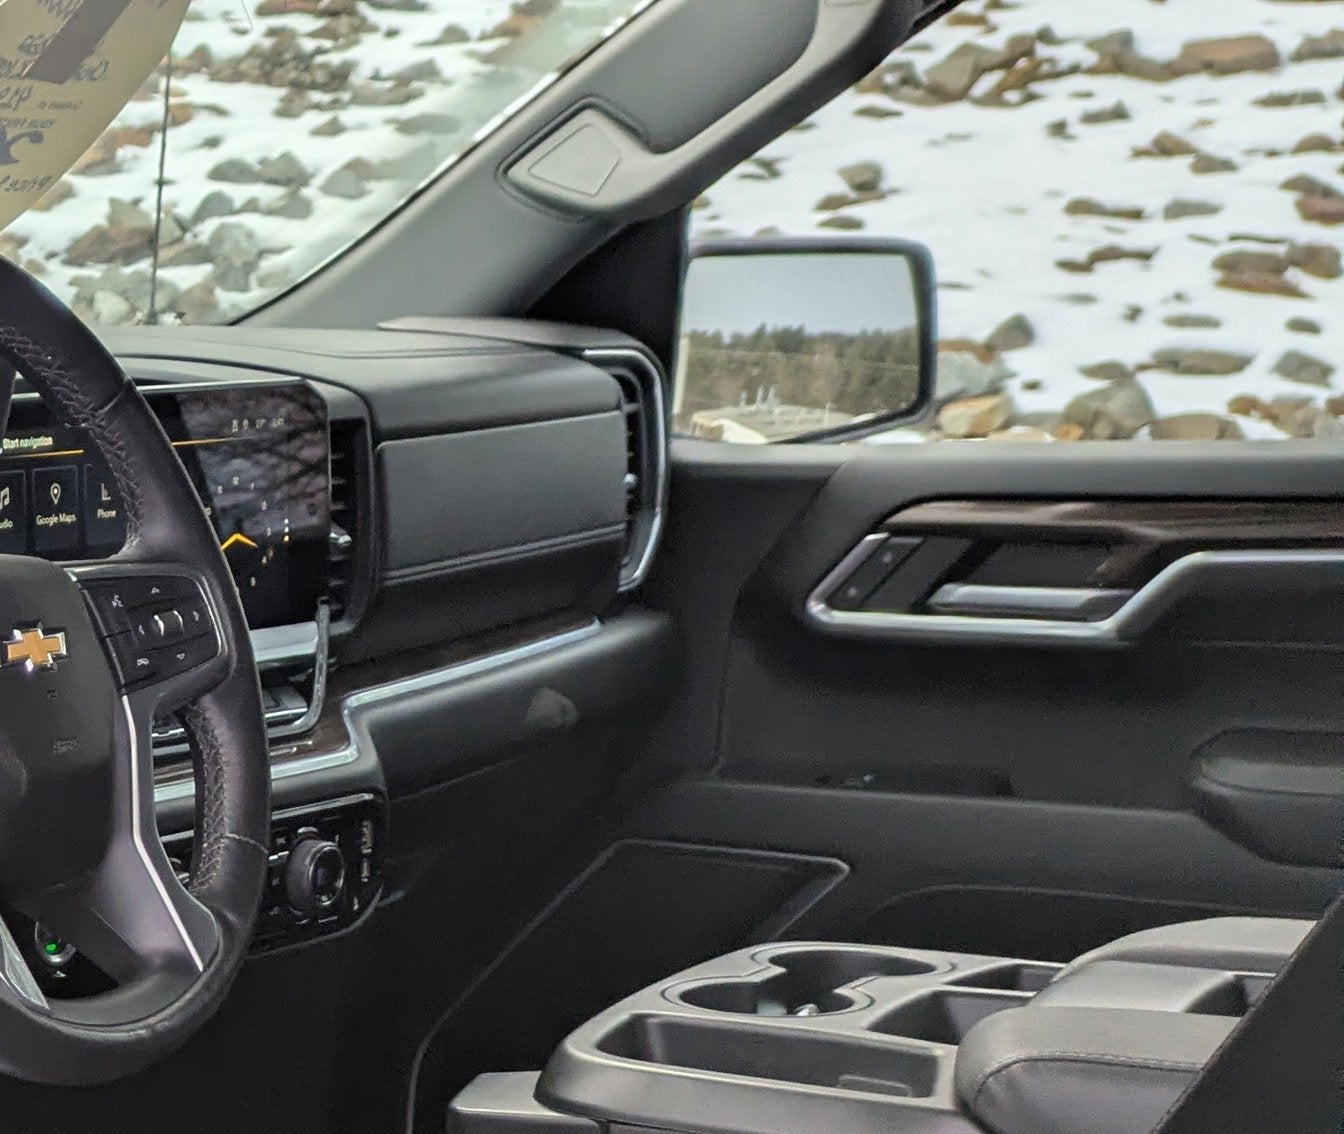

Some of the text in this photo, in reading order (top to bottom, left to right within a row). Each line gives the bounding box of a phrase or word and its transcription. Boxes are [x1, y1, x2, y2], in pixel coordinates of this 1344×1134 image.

[2, 436, 53, 449] Start navigation
[36, 513, 76, 527] Google Maps
[97, 508, 117, 519] Phone
